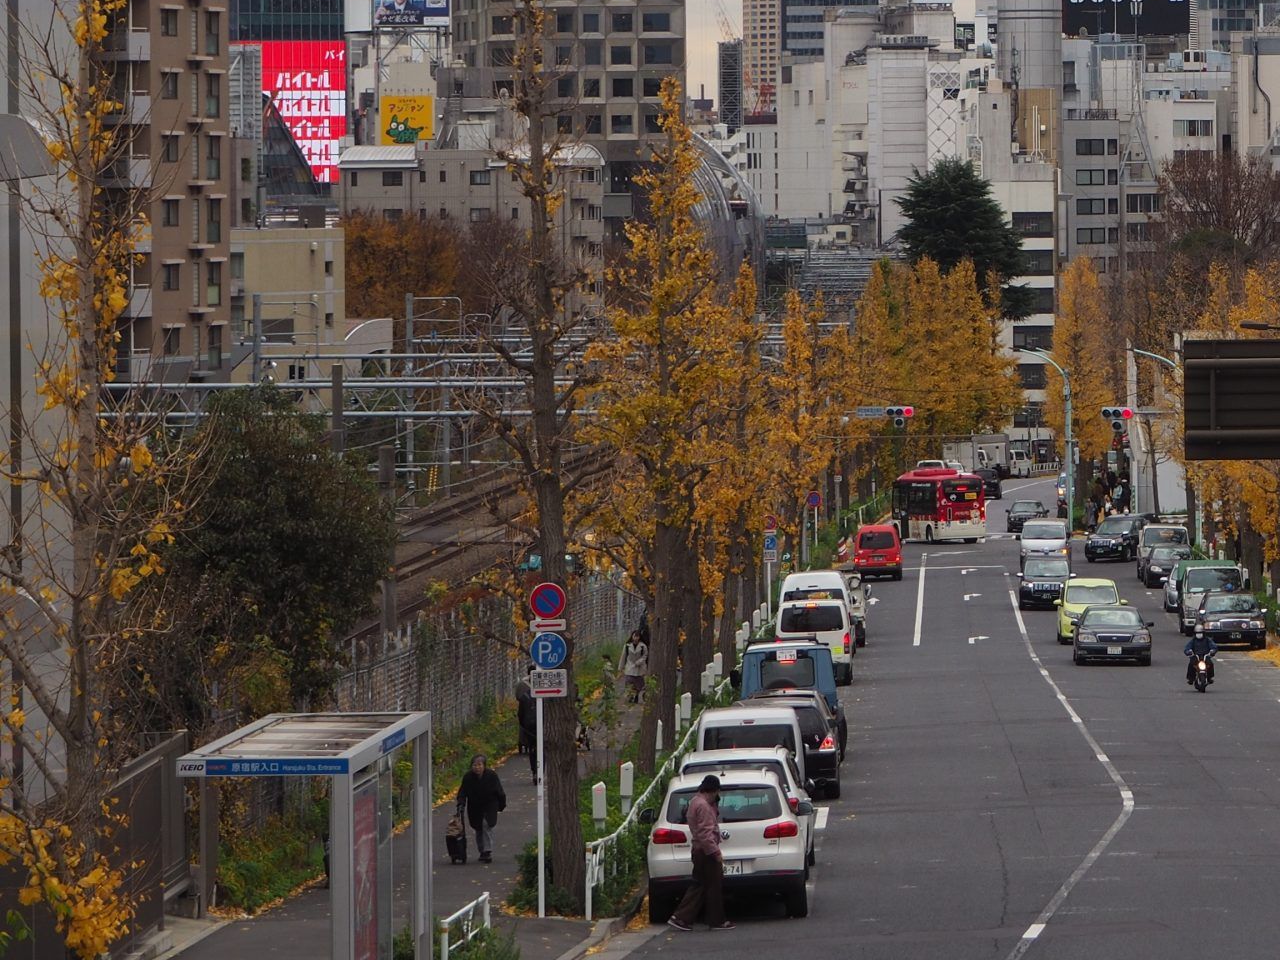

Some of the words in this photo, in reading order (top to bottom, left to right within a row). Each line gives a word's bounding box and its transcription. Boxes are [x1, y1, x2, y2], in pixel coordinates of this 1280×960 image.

[276, 70, 331, 88] バイトル
[538, 641, 552, 664] P
[547, 653, 558, 663] 60
[180, 764, 204, 772] KEIO
[231, 762, 279, 772] 原宿駅入口
